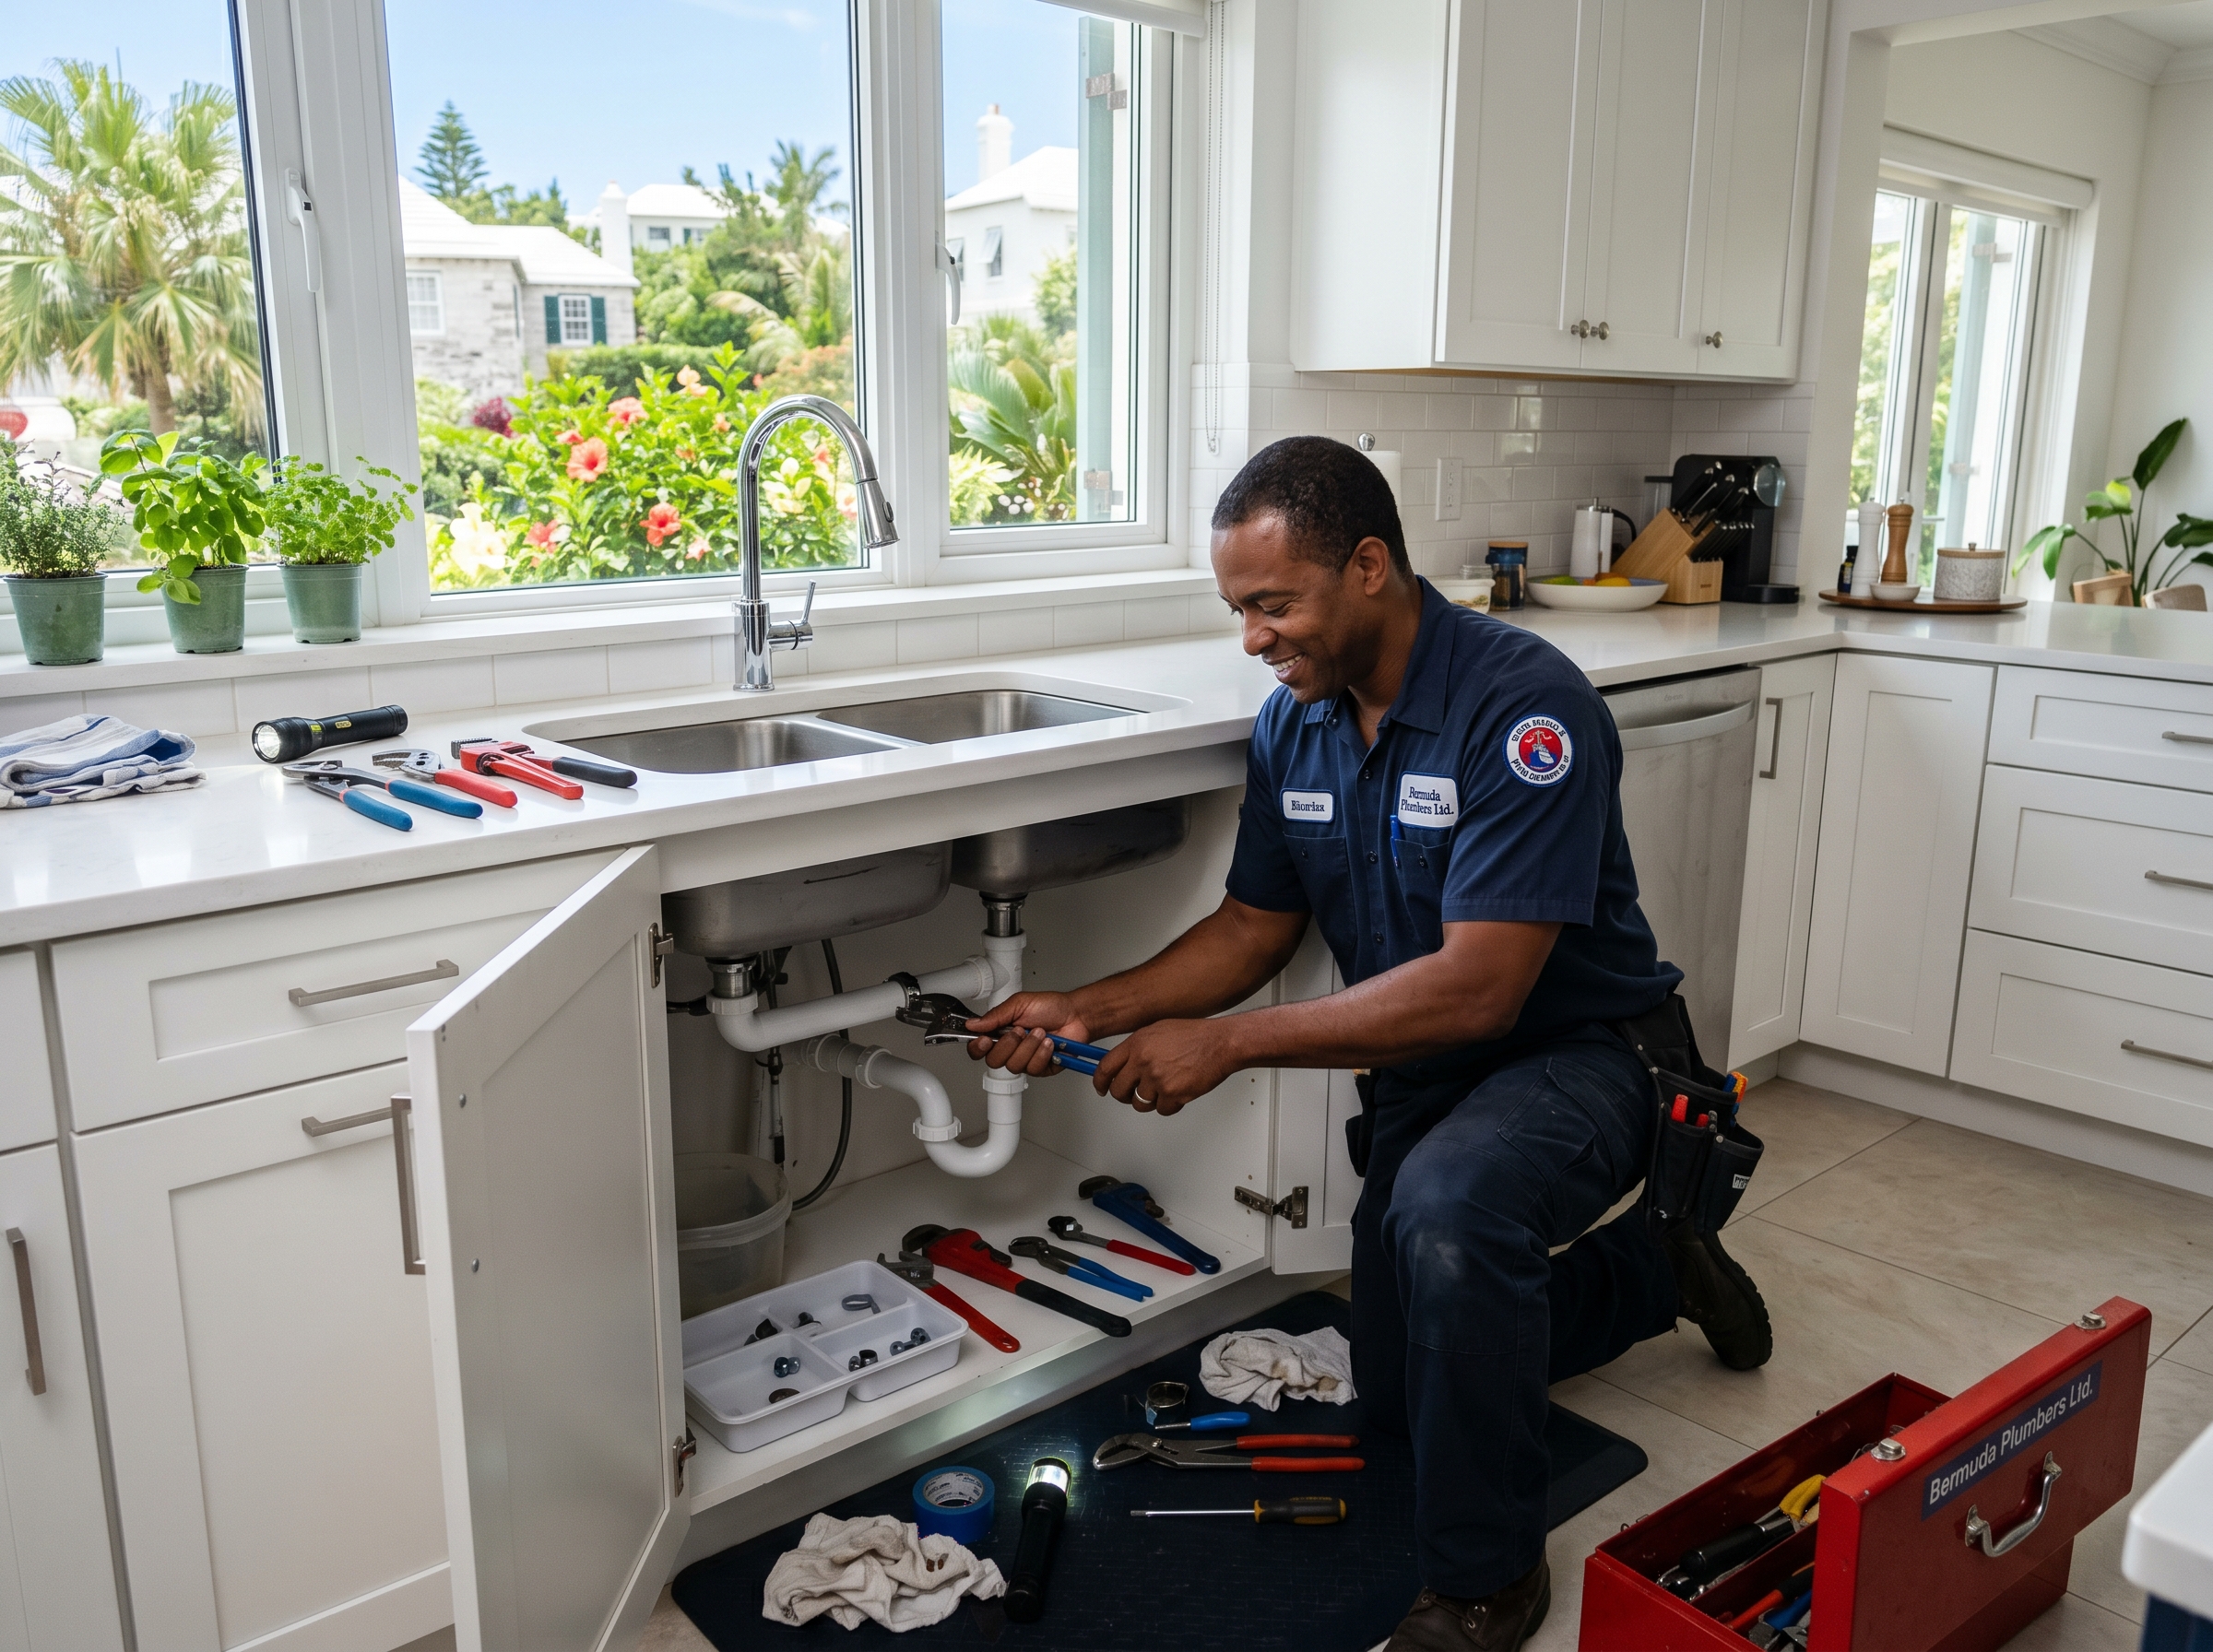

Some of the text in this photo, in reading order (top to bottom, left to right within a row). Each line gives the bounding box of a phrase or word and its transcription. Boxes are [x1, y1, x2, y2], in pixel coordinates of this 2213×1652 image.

[1929, 1374, 2093, 1504] Bermuda Plumbers Ltd.
